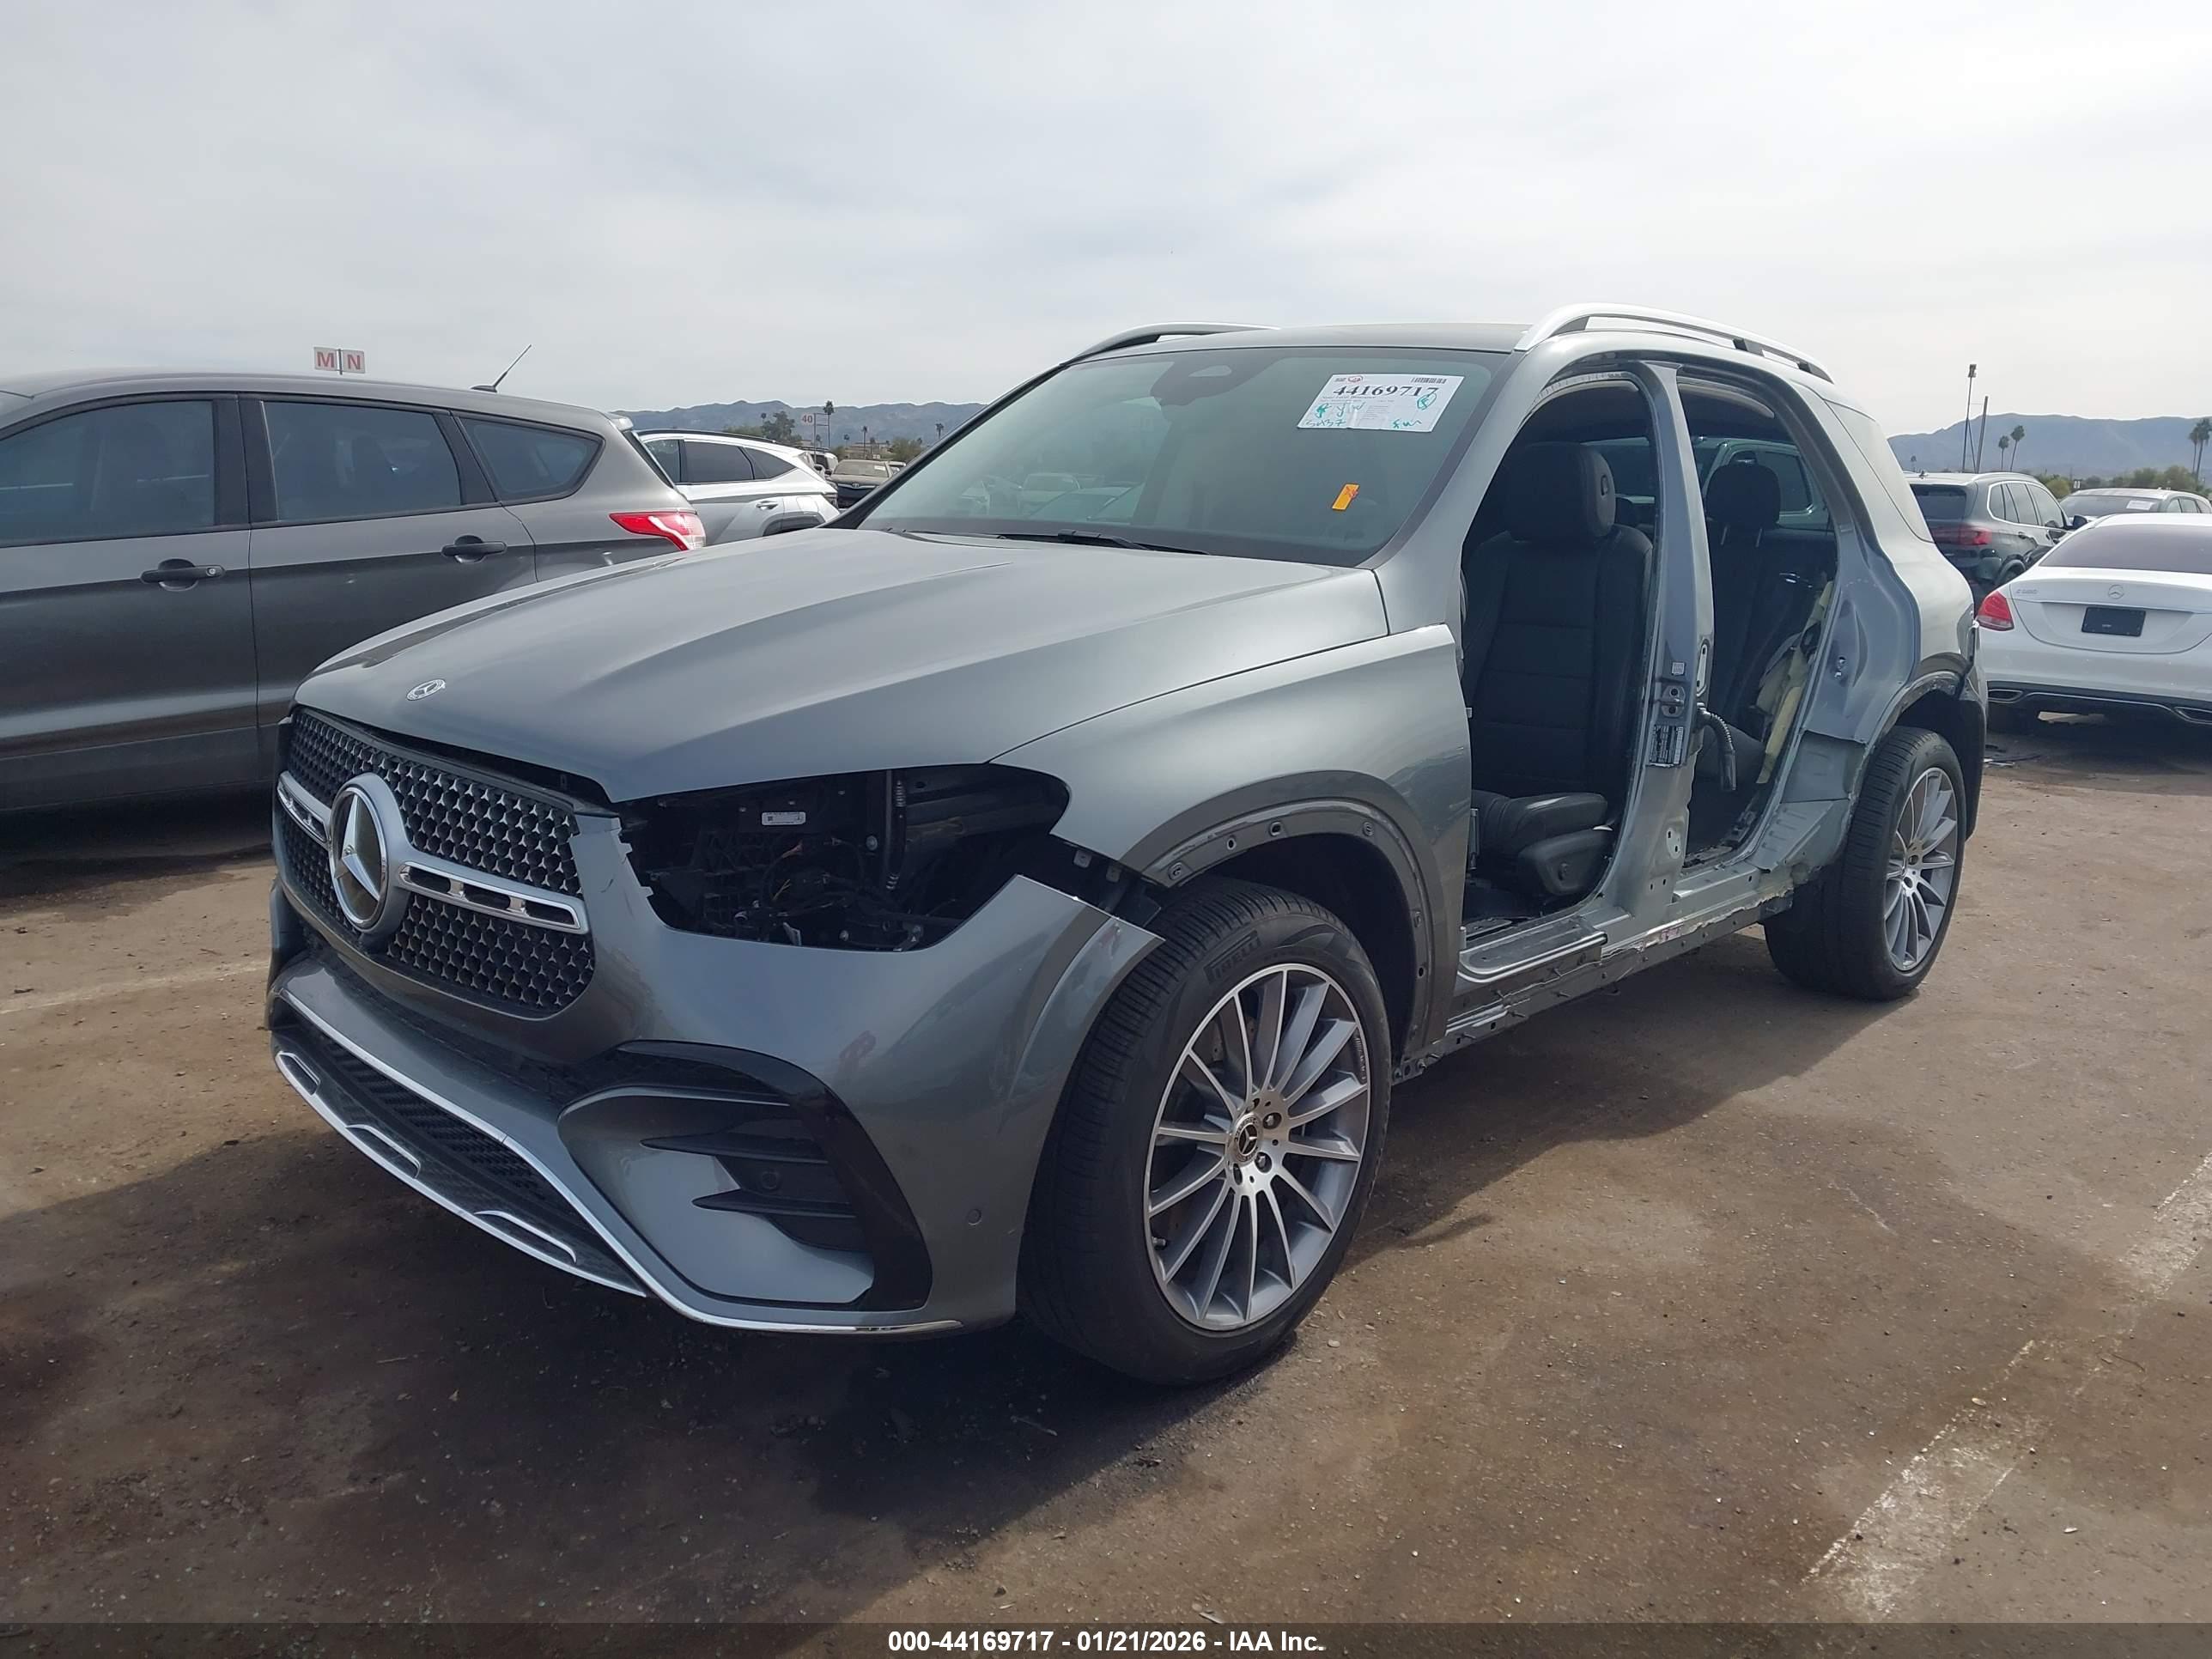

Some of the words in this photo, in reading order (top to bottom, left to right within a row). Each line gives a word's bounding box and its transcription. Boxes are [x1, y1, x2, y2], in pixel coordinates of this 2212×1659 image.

[317, 351, 335, 368] M
[347, 354, 362, 370] N
[1334, 386, 1439, 396] 44169717
[802, 415, 813, 423] 40
